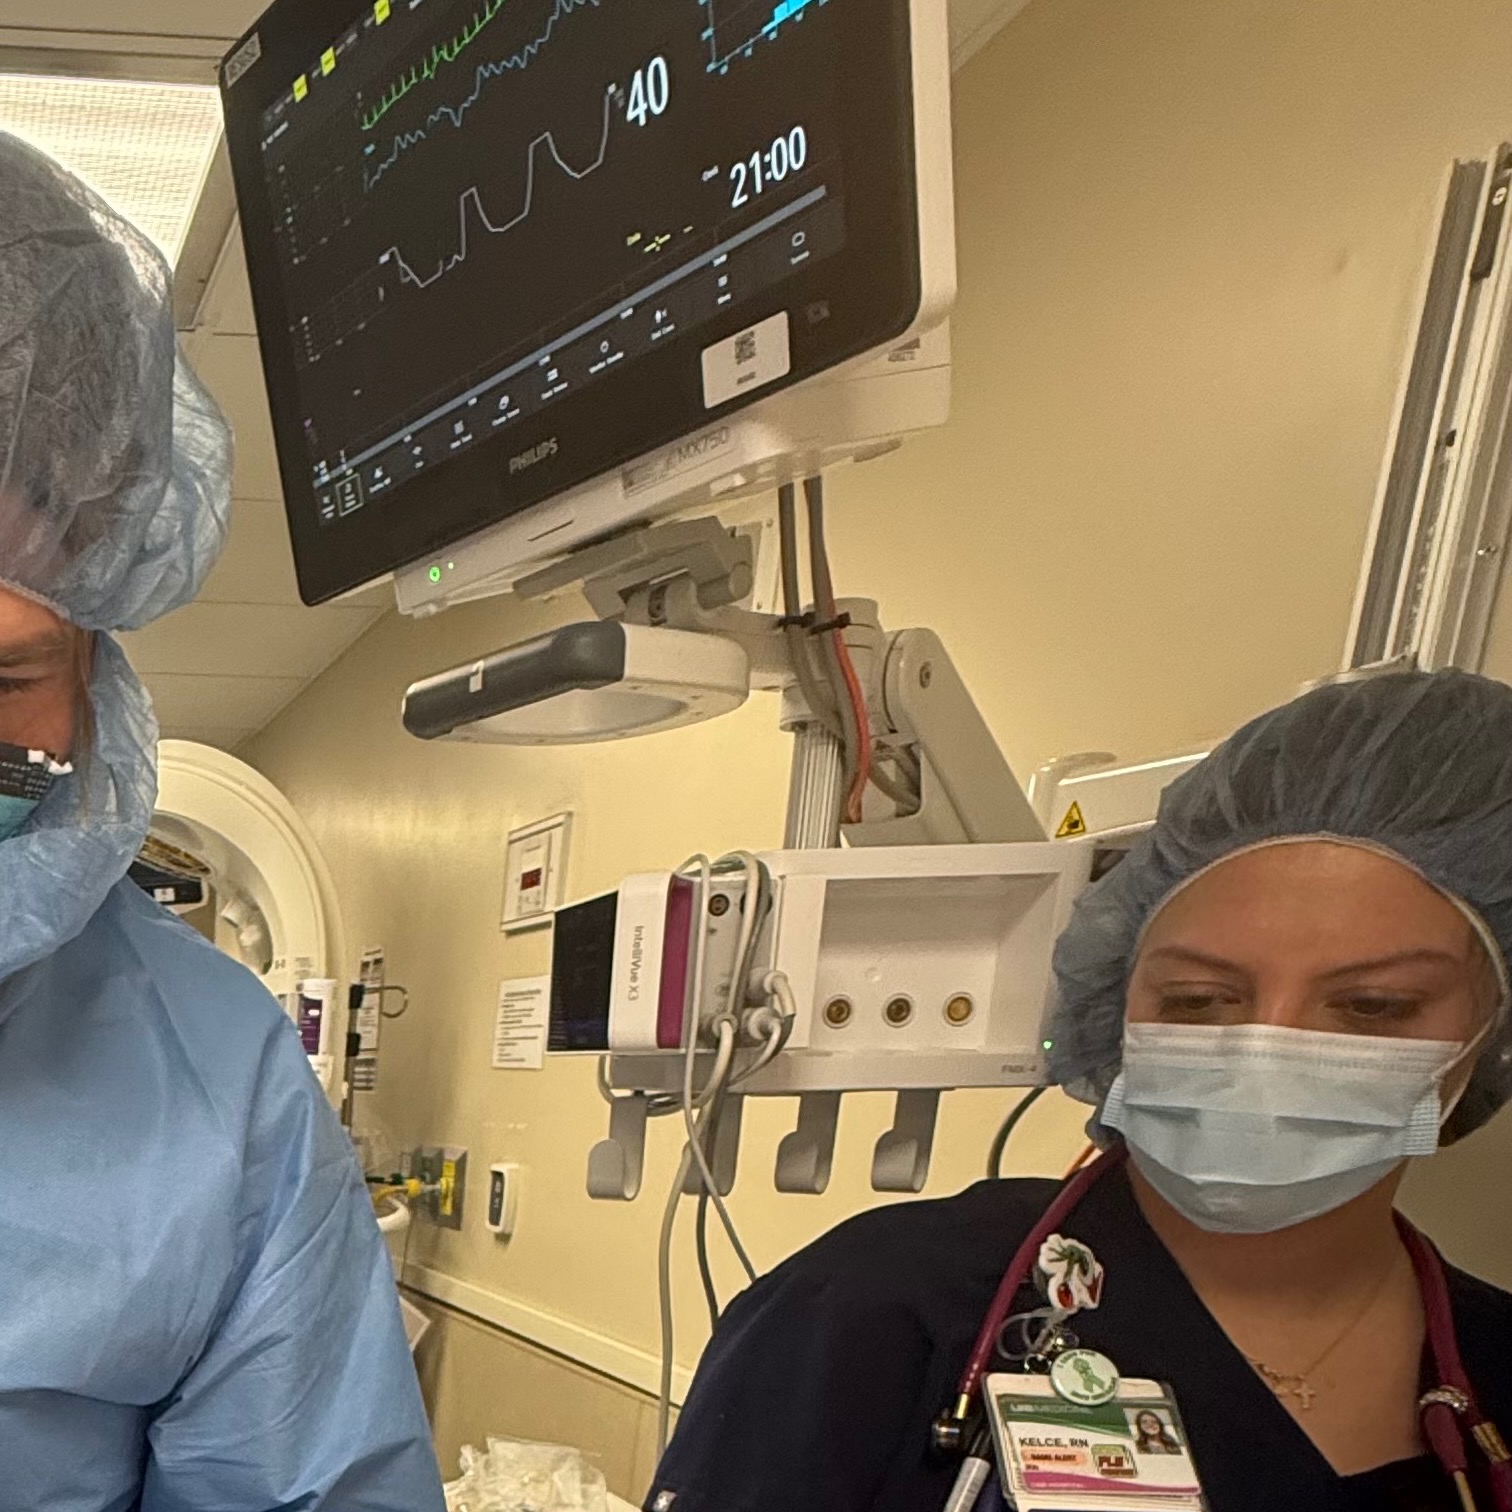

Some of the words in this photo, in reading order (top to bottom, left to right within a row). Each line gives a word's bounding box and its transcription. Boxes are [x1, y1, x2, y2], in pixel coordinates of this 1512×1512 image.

[626, 55, 669, 127] 40
[729, 125, 807, 208] 21:00
[509, 437, 558, 475] PHILIPS
[629, 925, 645, 983] IntelliVue
[627, 984, 640, 1001] X3
